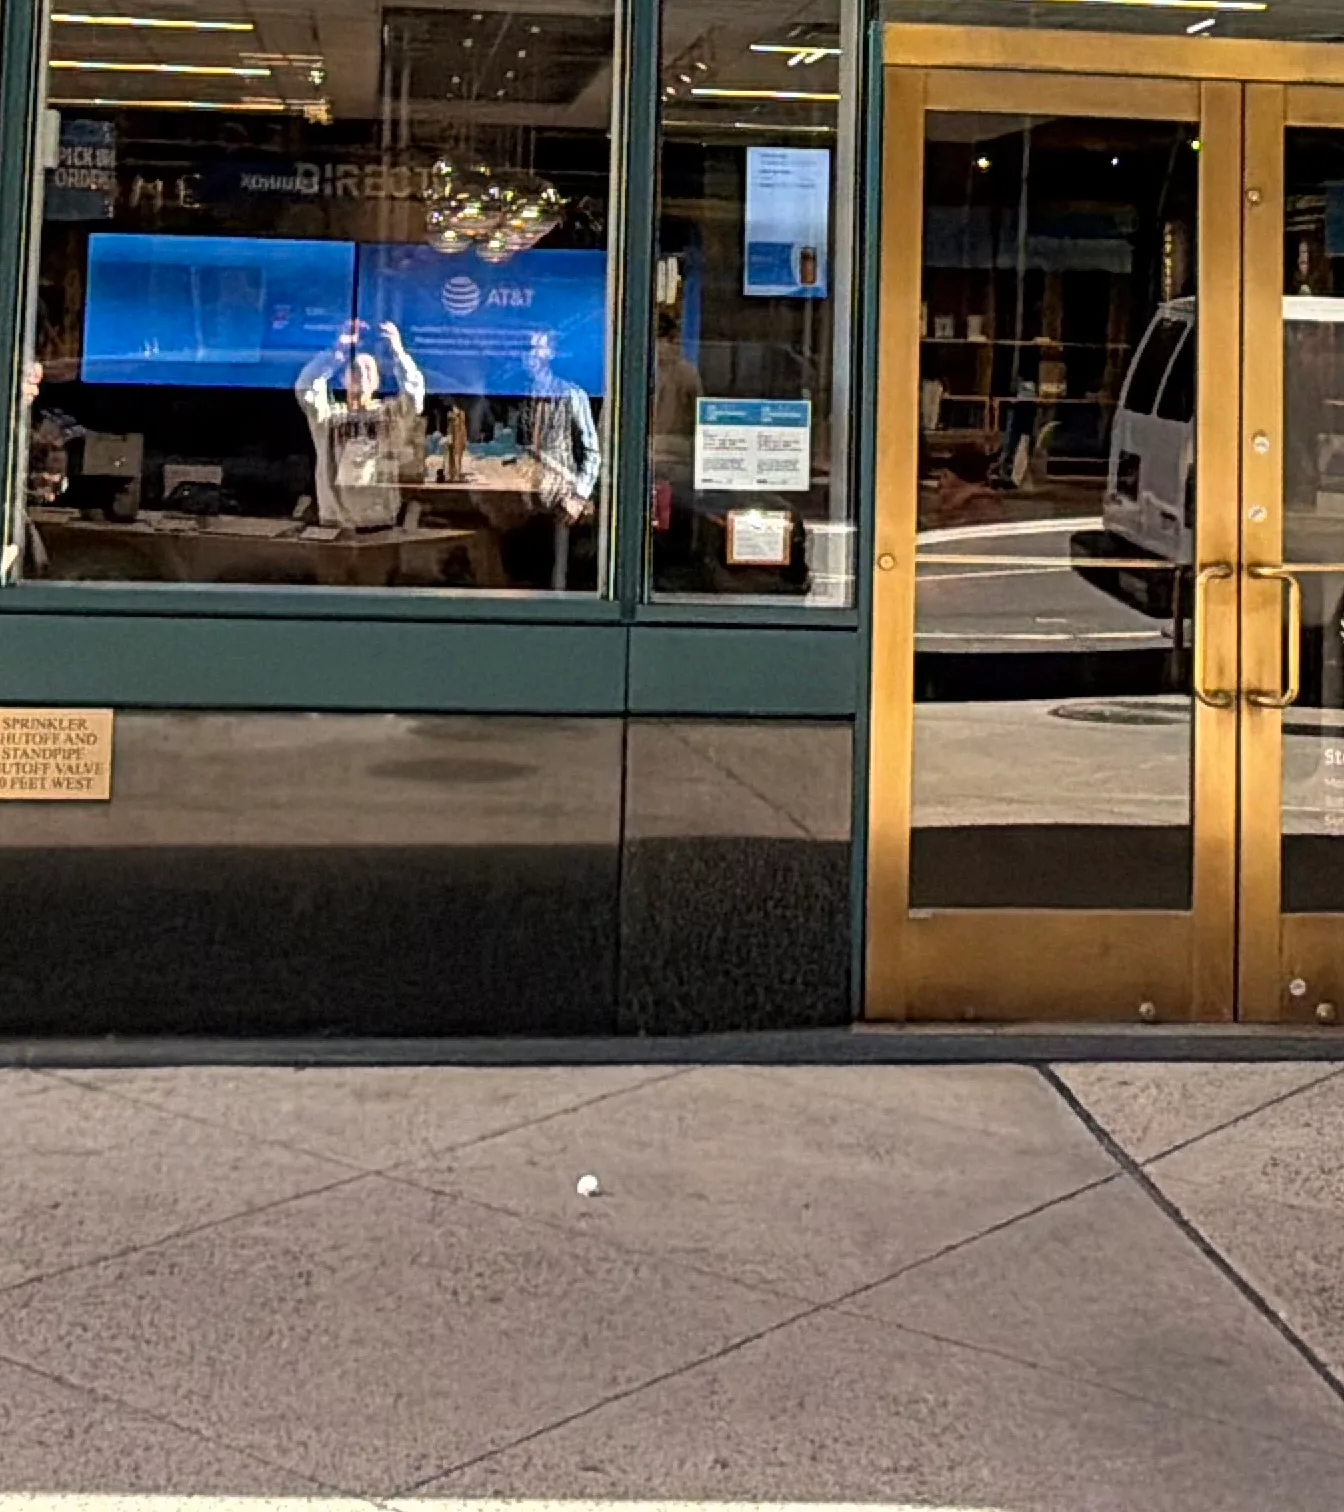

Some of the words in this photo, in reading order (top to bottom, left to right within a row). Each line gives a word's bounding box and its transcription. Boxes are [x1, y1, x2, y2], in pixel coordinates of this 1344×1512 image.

[486, 288, 535, 308] AT&T
[2, 716, 88, 731] SPRINKLER
[63, 732, 98, 746] AND
[1, 746, 86, 760] STANDPIPE
[55, 762, 104, 775] VALVE
[10, 776, 47, 790] FEET
[51, 776, 95, 790] WEST
